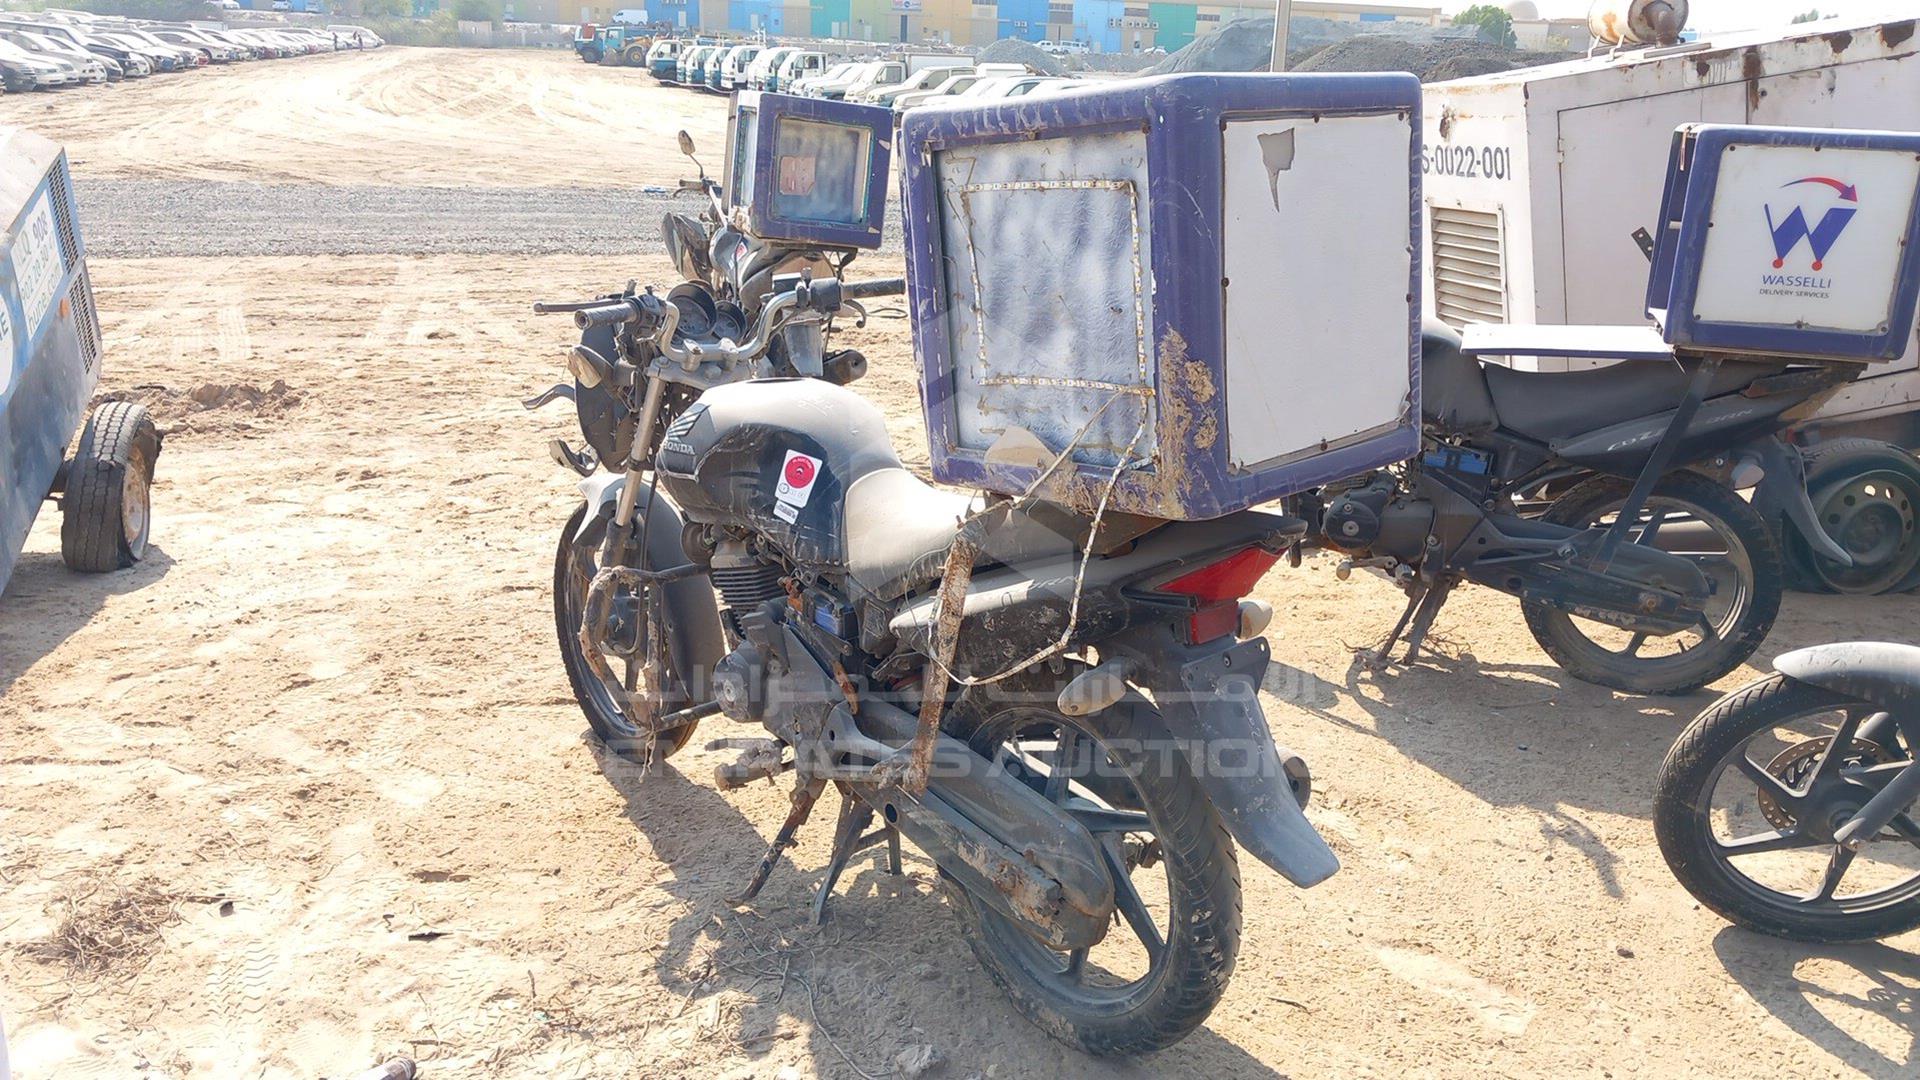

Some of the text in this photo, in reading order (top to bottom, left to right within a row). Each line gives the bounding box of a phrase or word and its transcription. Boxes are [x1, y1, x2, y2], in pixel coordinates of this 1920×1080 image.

[1761, 274, 1832, 289] WASSELLI
[1759, 288, 1830, 299] DELIVERY SERVICES
[662, 438, 696, 456] HONDA
